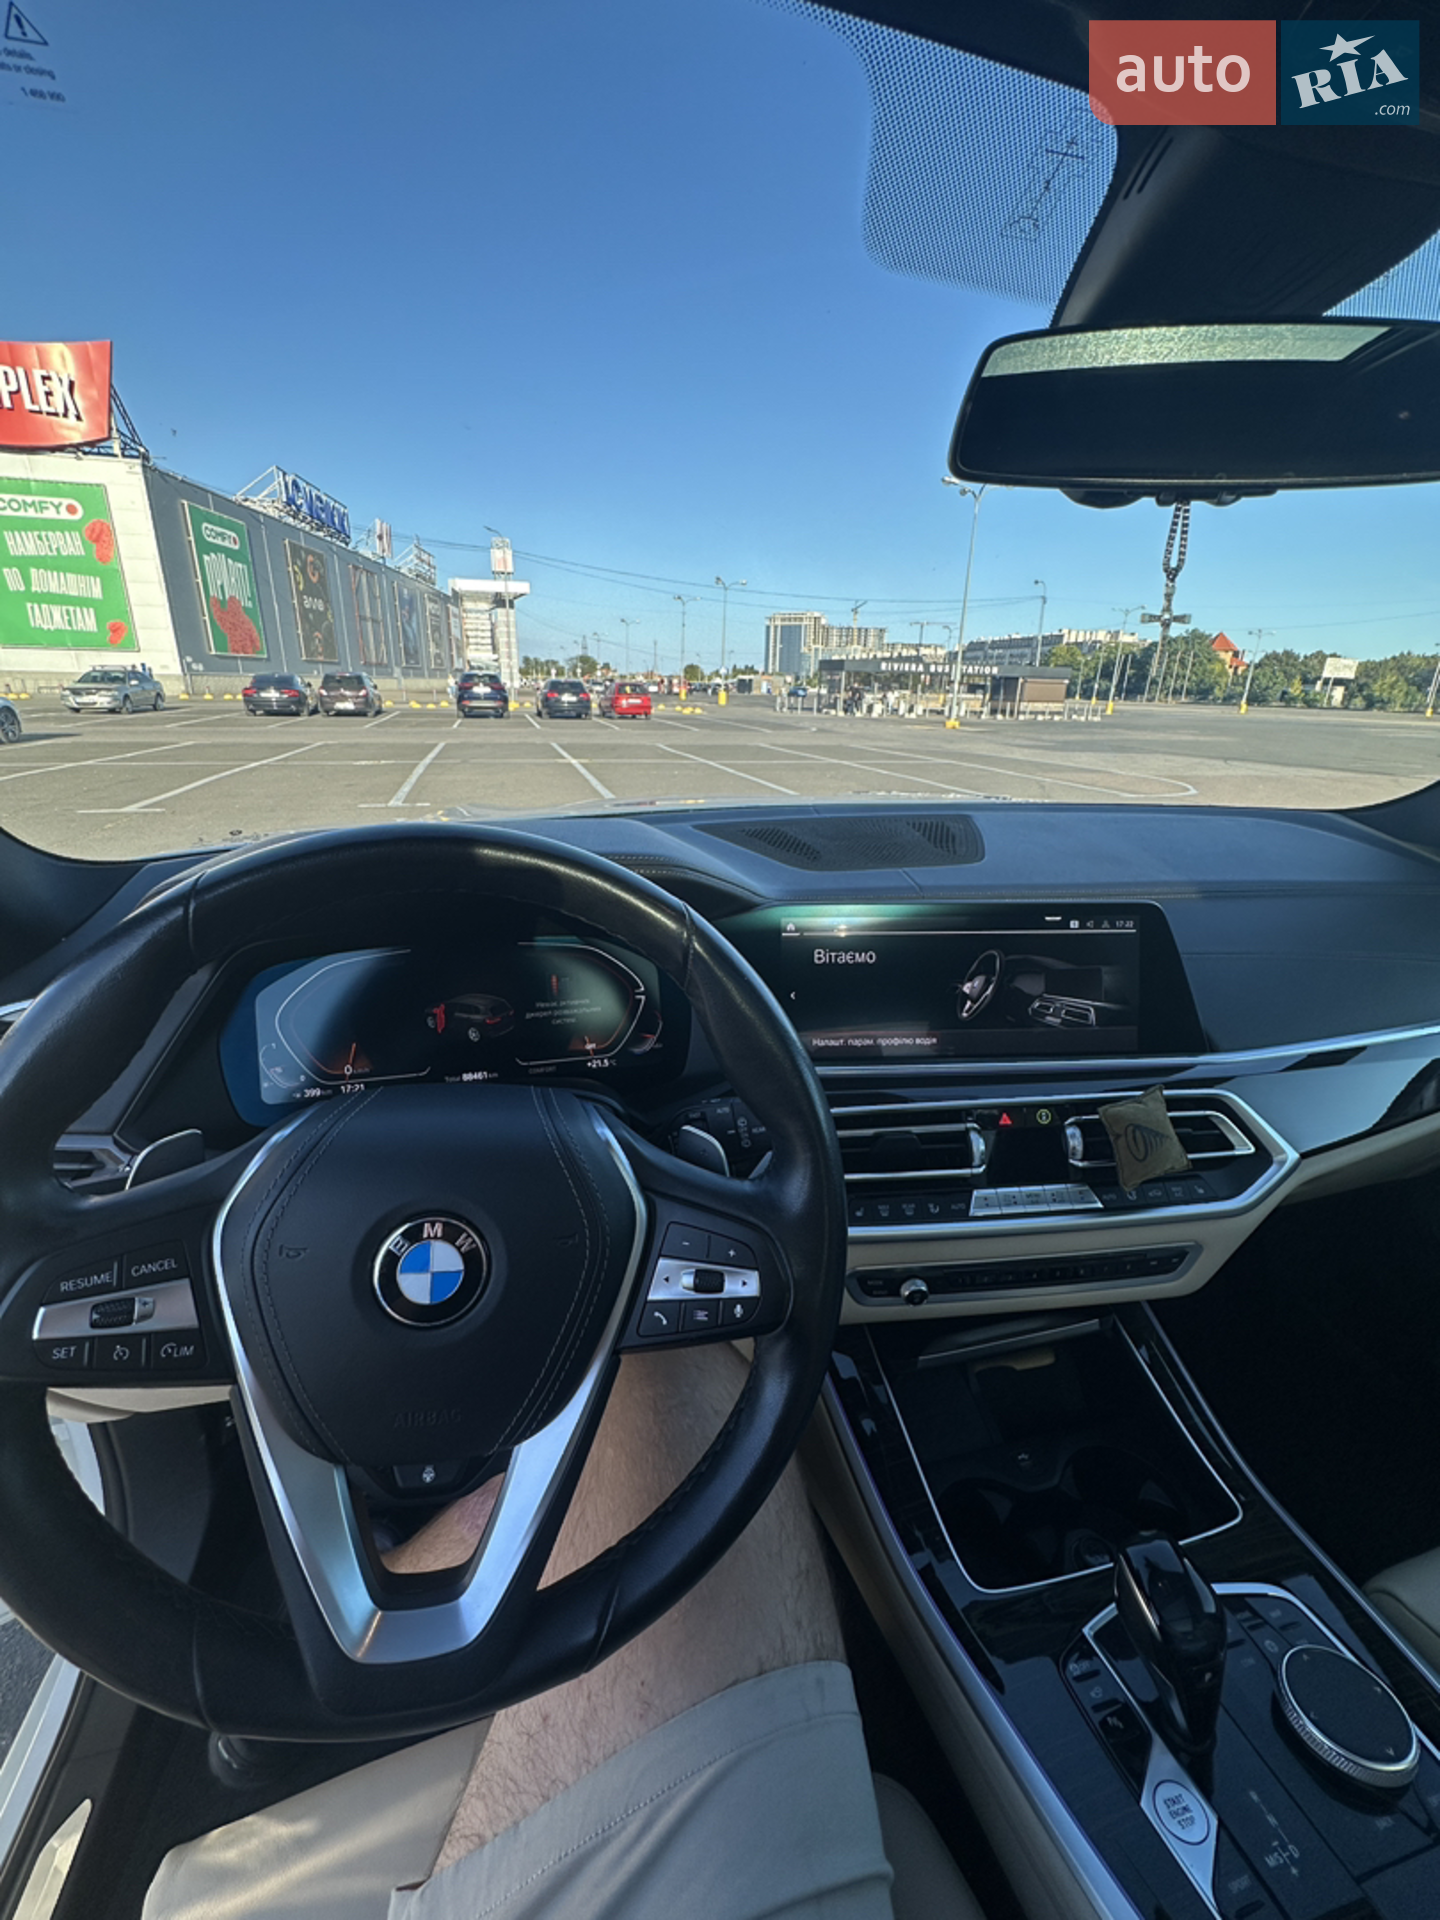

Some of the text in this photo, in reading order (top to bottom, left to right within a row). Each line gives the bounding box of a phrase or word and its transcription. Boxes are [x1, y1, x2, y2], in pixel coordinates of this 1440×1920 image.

[3, 531, 85, 556] НАМБЕРВАН
[2, 567, 103, 600] ПО ДОМАШНІМ
[26, 602, 98, 632] ГАДЖЕТАМ
[881, 661, 998, 674] RIVIERA BUS TATION
[813, 948, 877, 964] Вітаємо
[344, 1064, 353, 1075] 0
[388, 1222, 478, 1257] BMW
[130, 1258, 178, 1277] CANCEL
[59, 1270, 113, 1293] RESUME
[52, 1345, 78, 1360] SET
[172, 1345, 194, 1358] LIM
[1163, 1793, 1185, 1809] START
[1168, 1804, 1194, 1820] ENGINE
[1177, 1815, 1196, 1830] STOP
